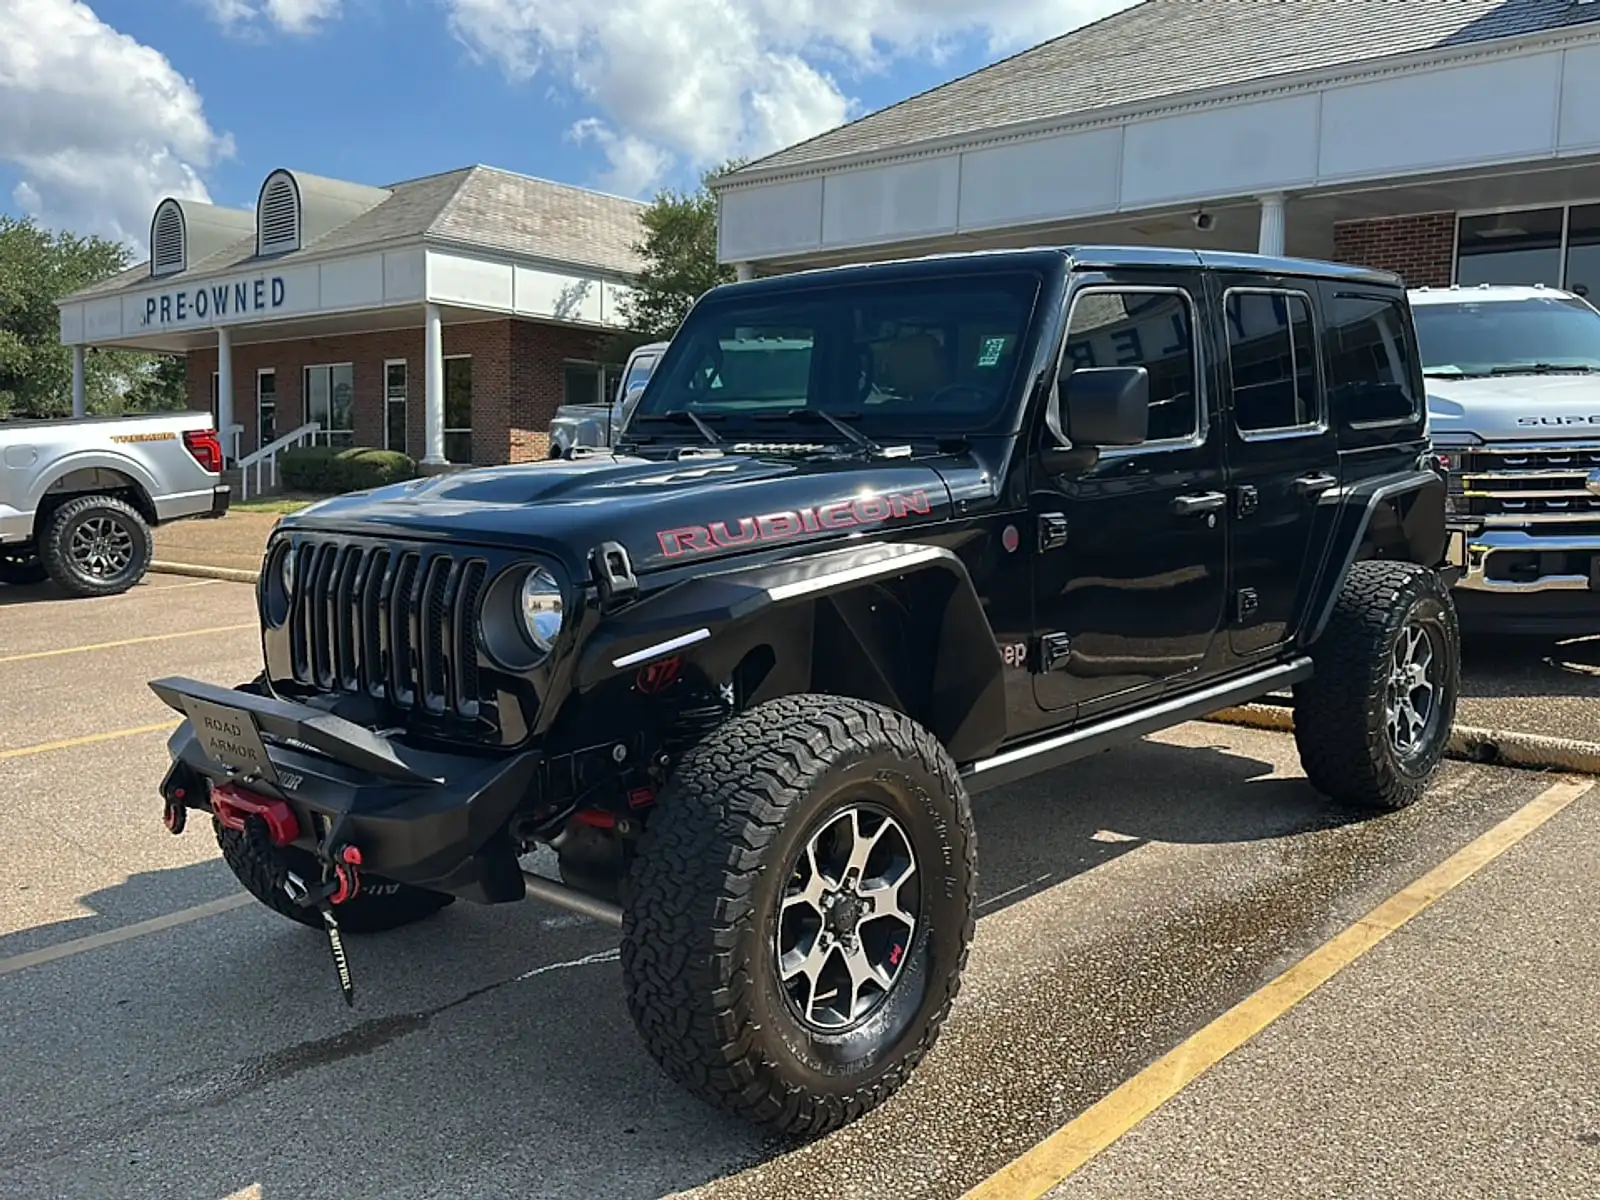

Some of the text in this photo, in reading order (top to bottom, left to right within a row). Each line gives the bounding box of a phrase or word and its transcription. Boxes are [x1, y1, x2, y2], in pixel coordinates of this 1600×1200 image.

[146, 276, 285, 325] PRE-OWNED
[657, 489, 932, 558] RUBICON
[204, 717, 241, 736] ROAD
[210, 737, 257, 760] ARMOR
